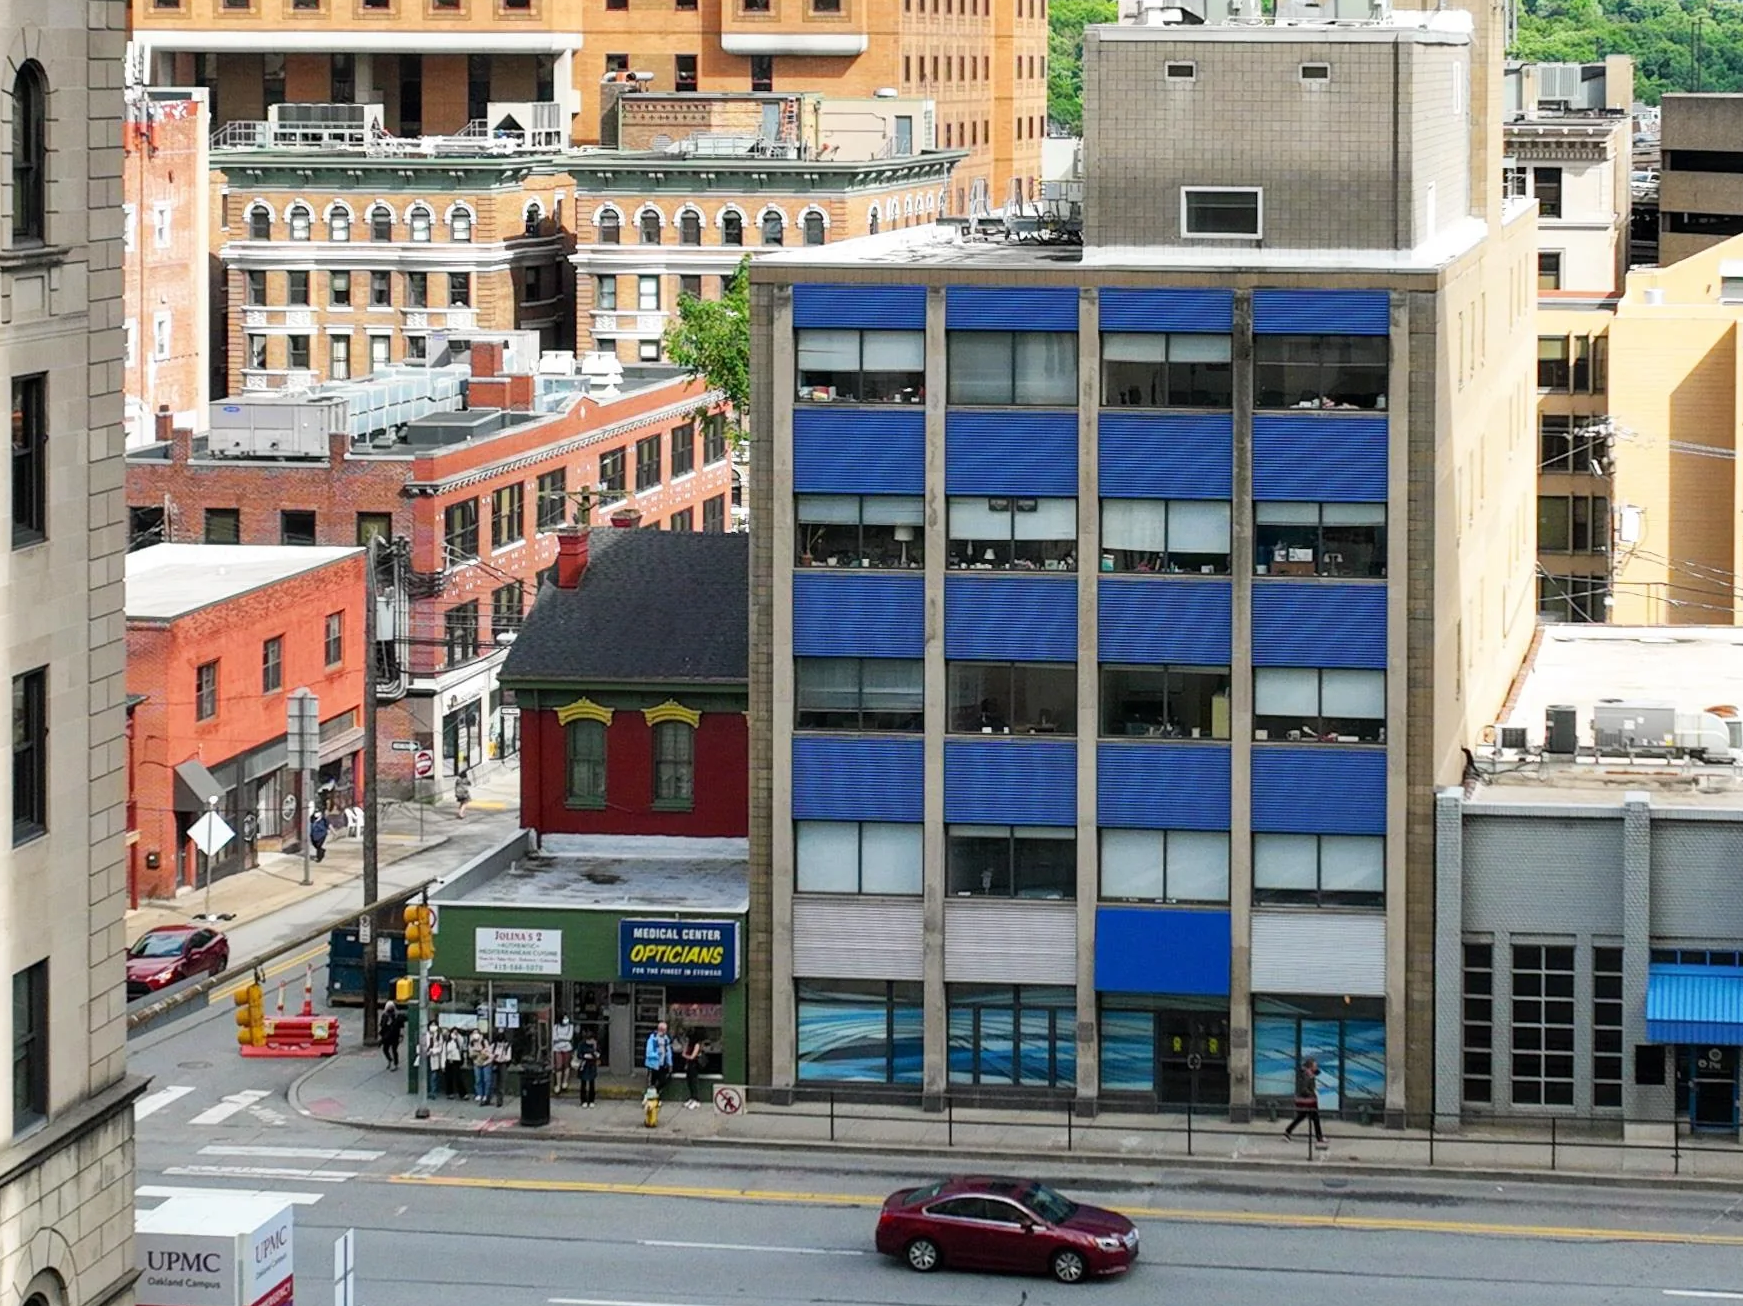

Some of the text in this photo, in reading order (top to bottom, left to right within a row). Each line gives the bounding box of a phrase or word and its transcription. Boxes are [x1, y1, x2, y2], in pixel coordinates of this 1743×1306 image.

[536, 932, 543, 942] 2
[633, 927, 721, 941] MEDICAL CENTER
[630, 944, 724, 965] OPTICIANS
[255, 1225, 288, 1264] UPMC
[147, 1250, 222, 1273] UPMC
[147, 1277, 221, 1290] Oakland Campus
